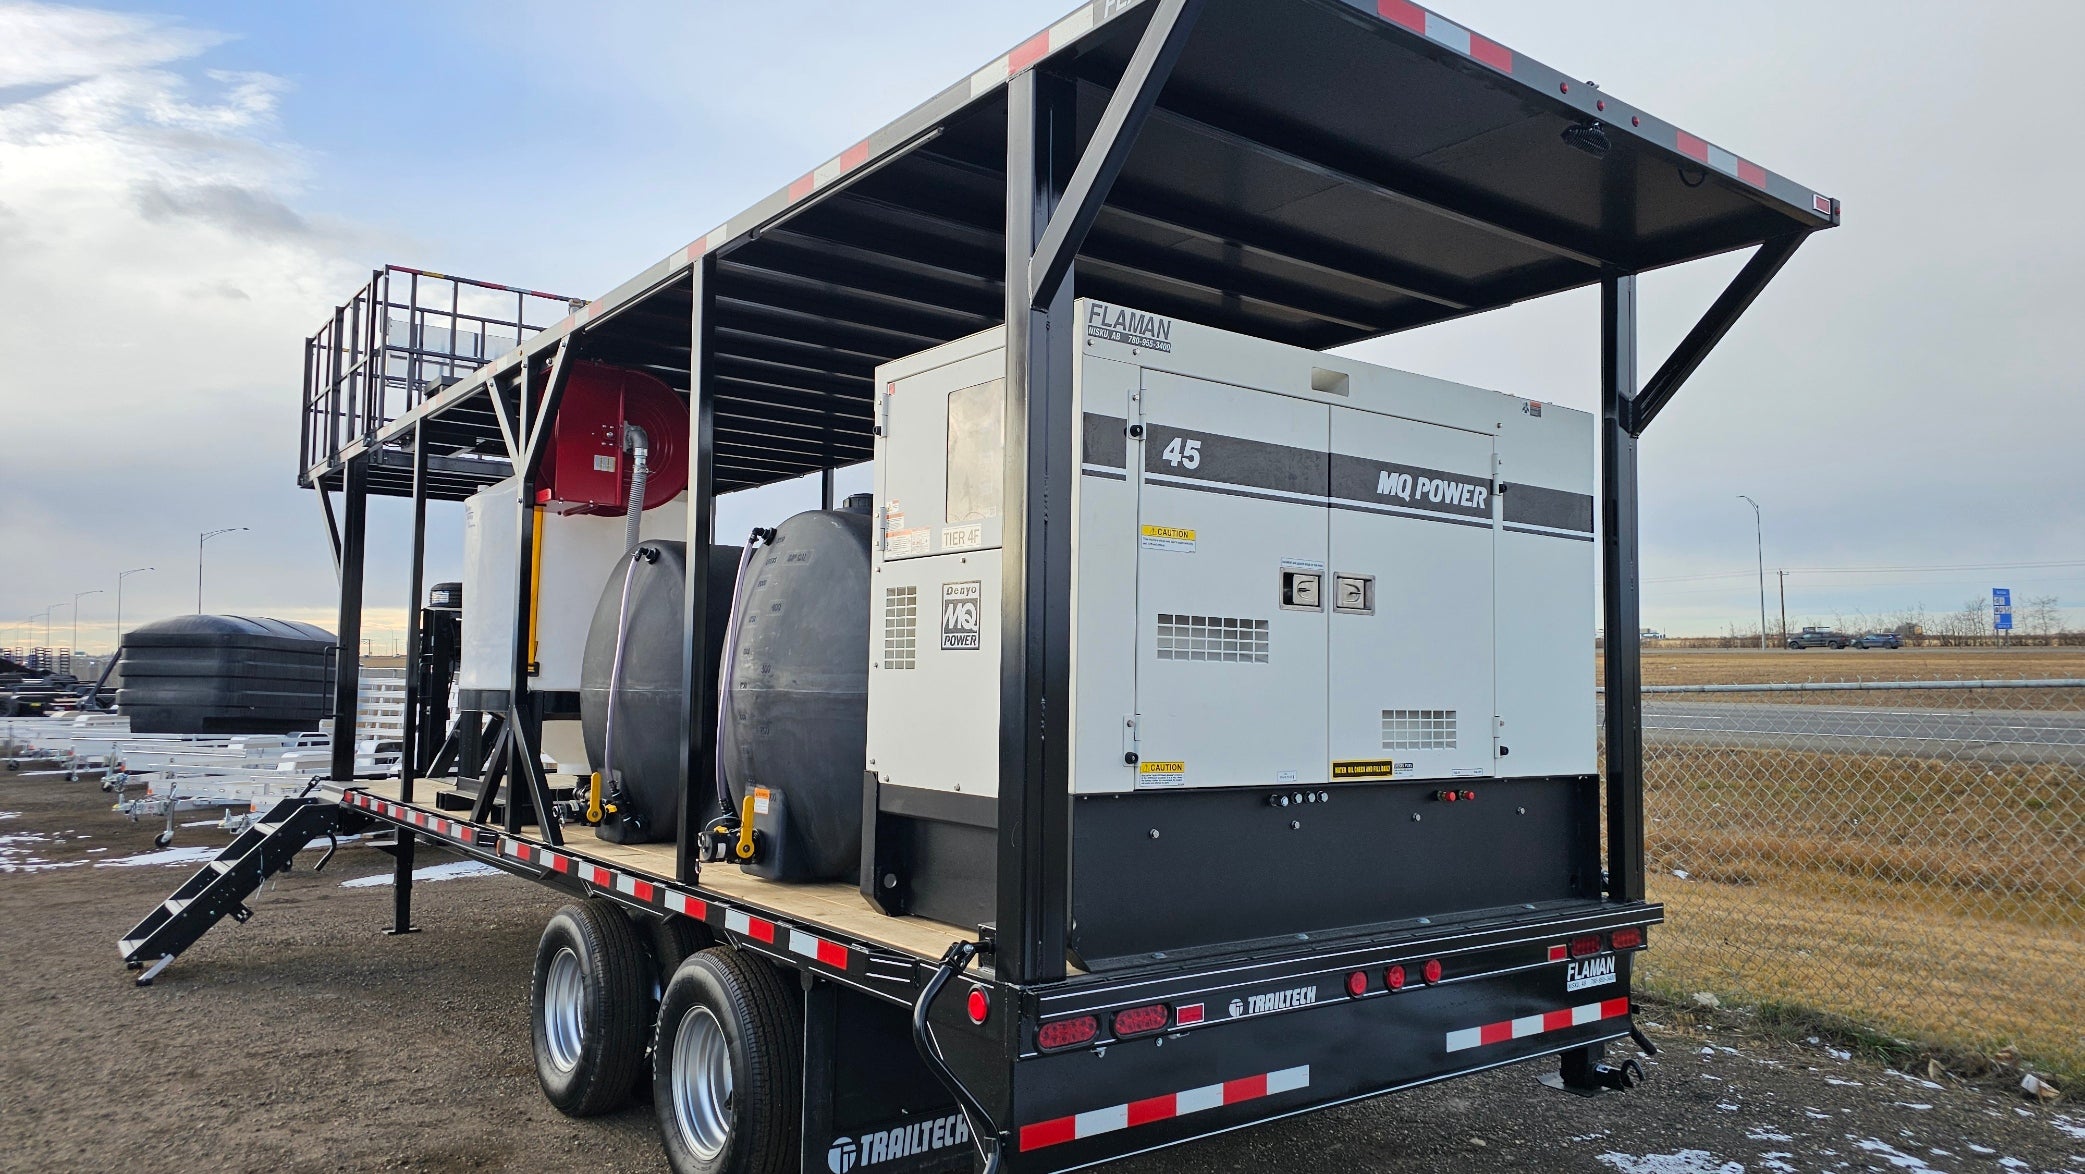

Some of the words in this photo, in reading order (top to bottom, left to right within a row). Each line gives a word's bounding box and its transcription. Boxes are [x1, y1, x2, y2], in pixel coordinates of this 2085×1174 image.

[1088, 302, 1172, 340] FLAMAN
[1111, 332, 1121, 340] AB
[1162, 437, 1202, 470] 45
[1376, 470, 1413, 502] MQ
[1415, 476, 1488, 509] POWER
[944, 530, 966, 547] TIER
[967, 528, 980, 544] 4F
[1157, 528, 1189, 538] CAUTION
[946, 586, 977, 597] Denyo
[944, 602, 979, 631] MQ
[944, 634, 977, 647] POWER
[1150, 763, 1183, 772] CAUTION
[1566, 955, 1616, 982] FLAMAN
[1247, 985, 1317, 1014] TRAILTECH
[860, 1113, 969, 1167] TRAILTECH
